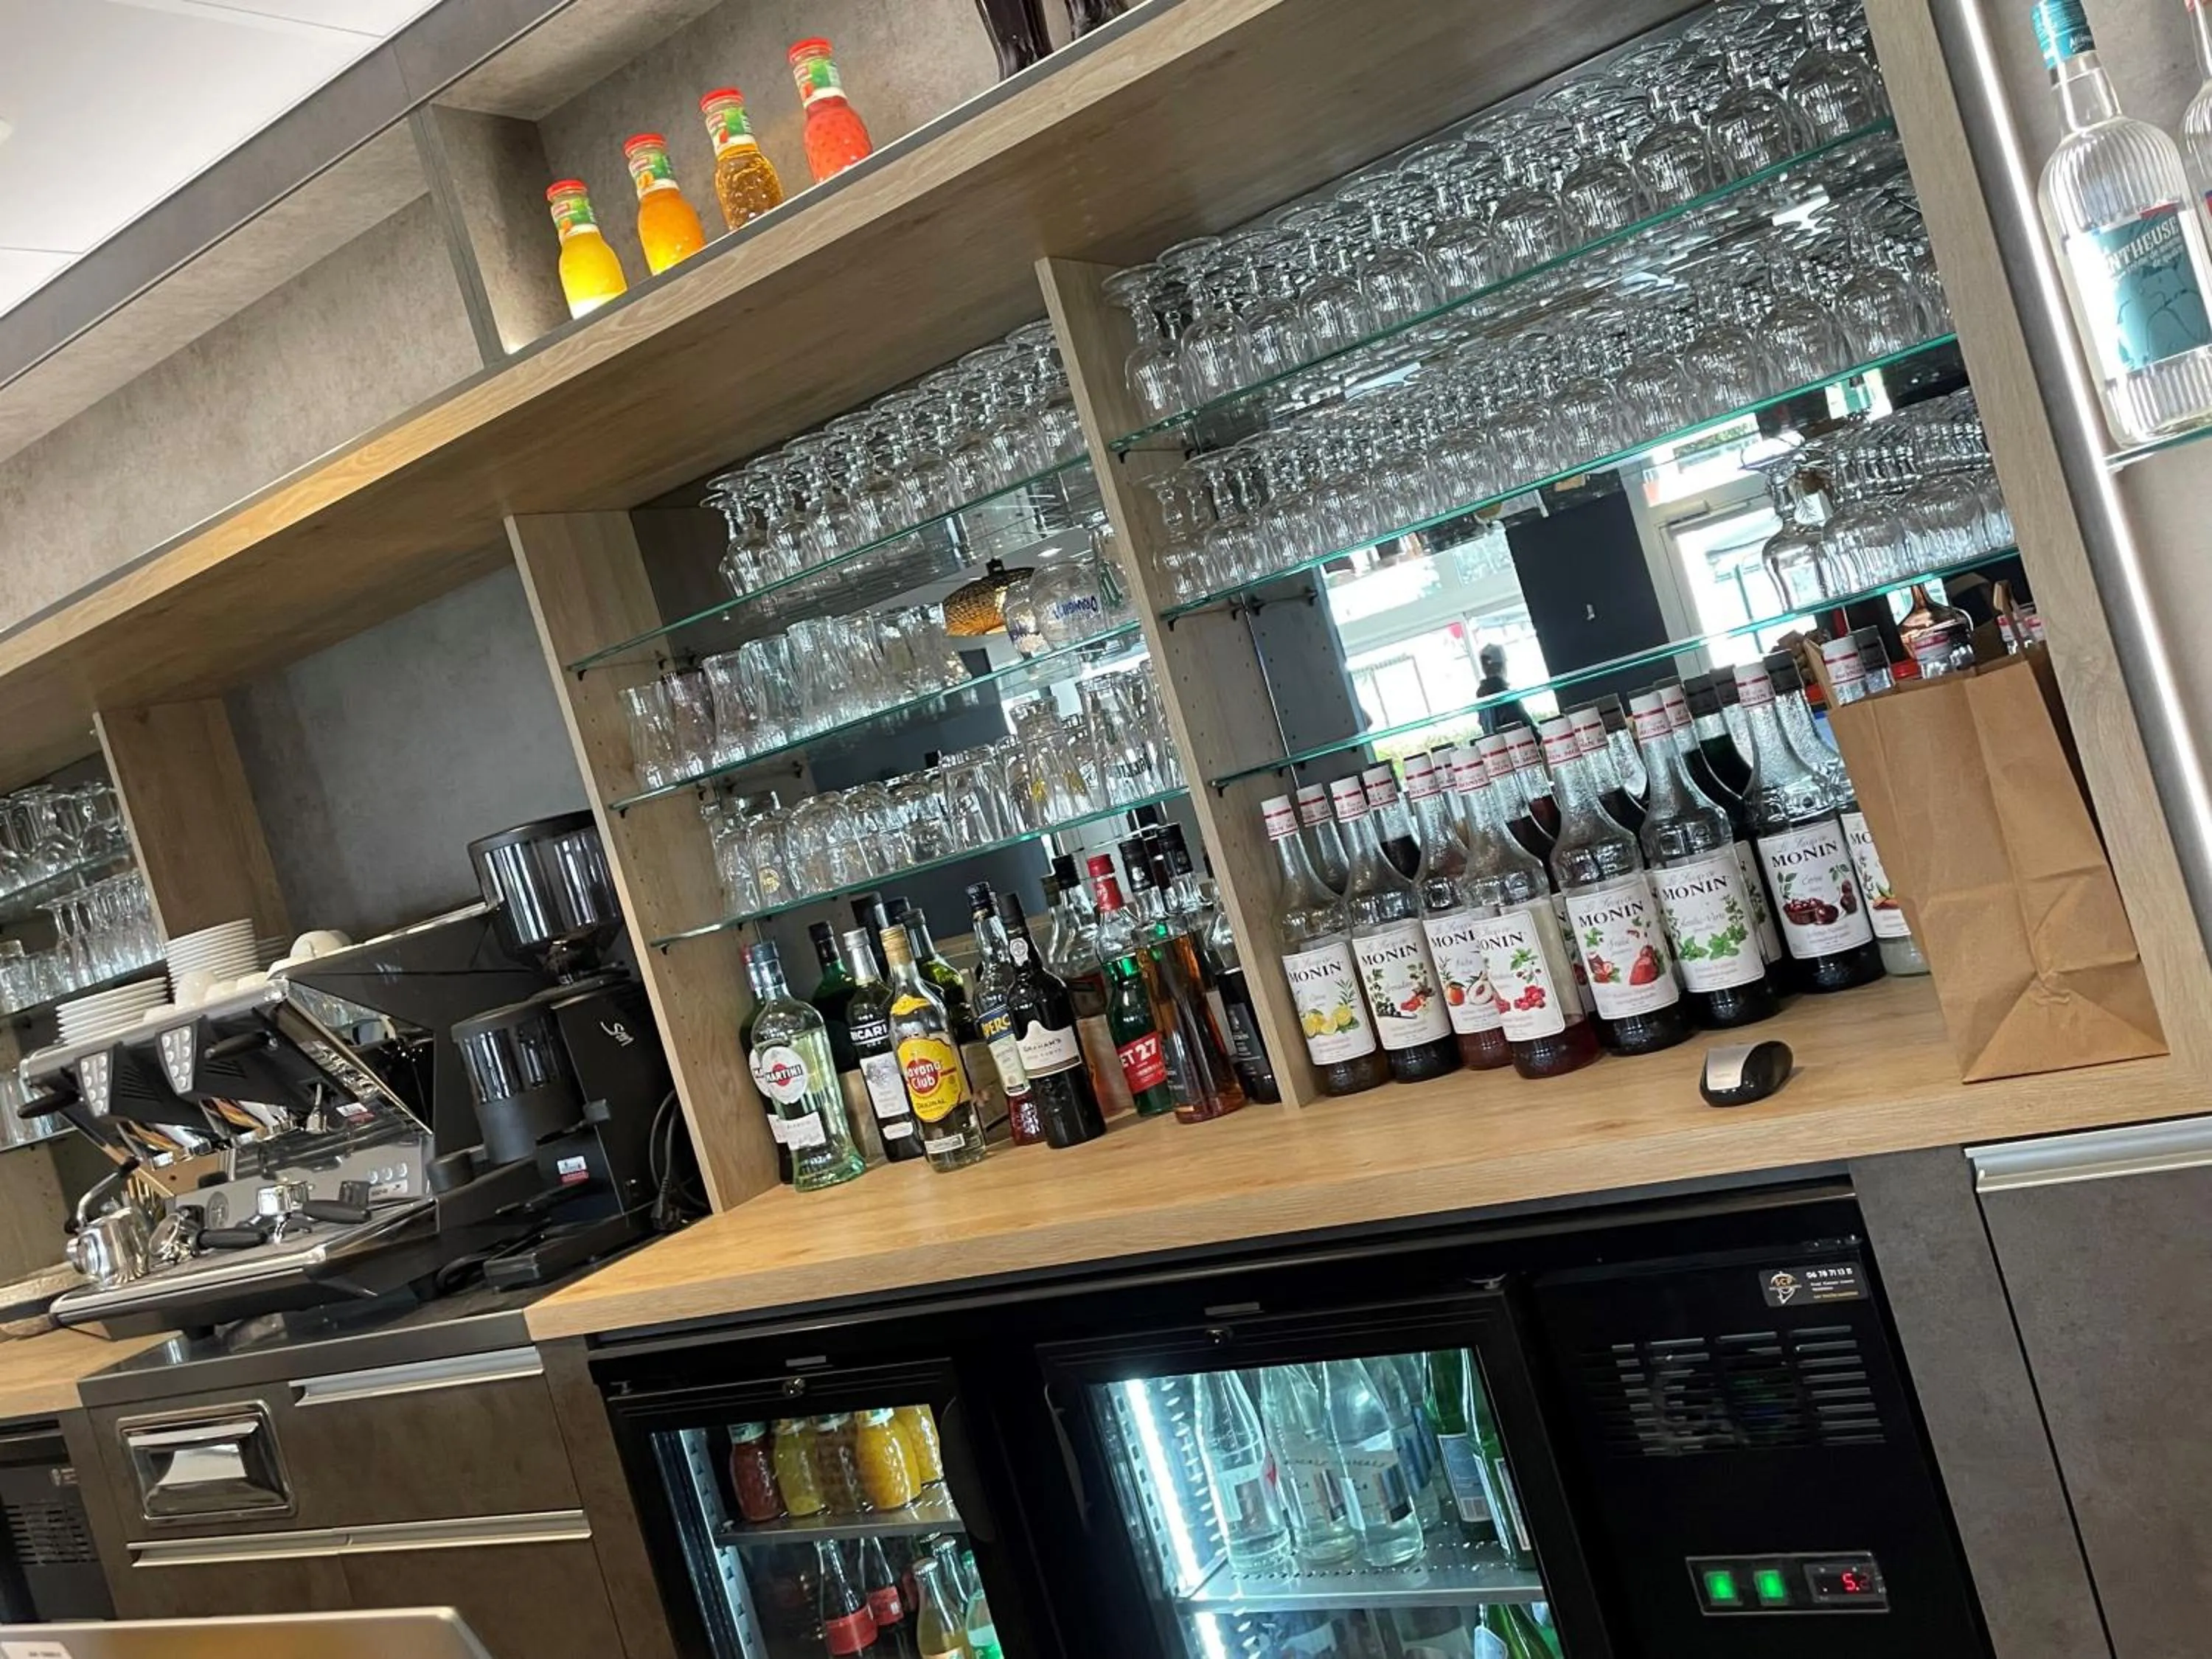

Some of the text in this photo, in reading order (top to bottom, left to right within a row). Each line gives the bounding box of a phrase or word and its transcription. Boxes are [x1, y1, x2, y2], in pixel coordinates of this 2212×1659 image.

[2107, 216, 2179, 274] NTHEUSE
[1771, 840, 1838, 868] MONIN
[1663, 875, 1728, 901] MONIN
[1578, 900, 1644, 927] MONIN
[1430, 929, 1475, 947] MONI
[1479, 931, 1525, 950] ONIN
[1361, 942, 1419, 966] MONIN
[1289, 961, 1342, 983] MONIN
[1119, 1037, 1157, 1068] ET 27
[908, 1060, 942, 1077] avana
[911, 1075, 936, 1090] Club
